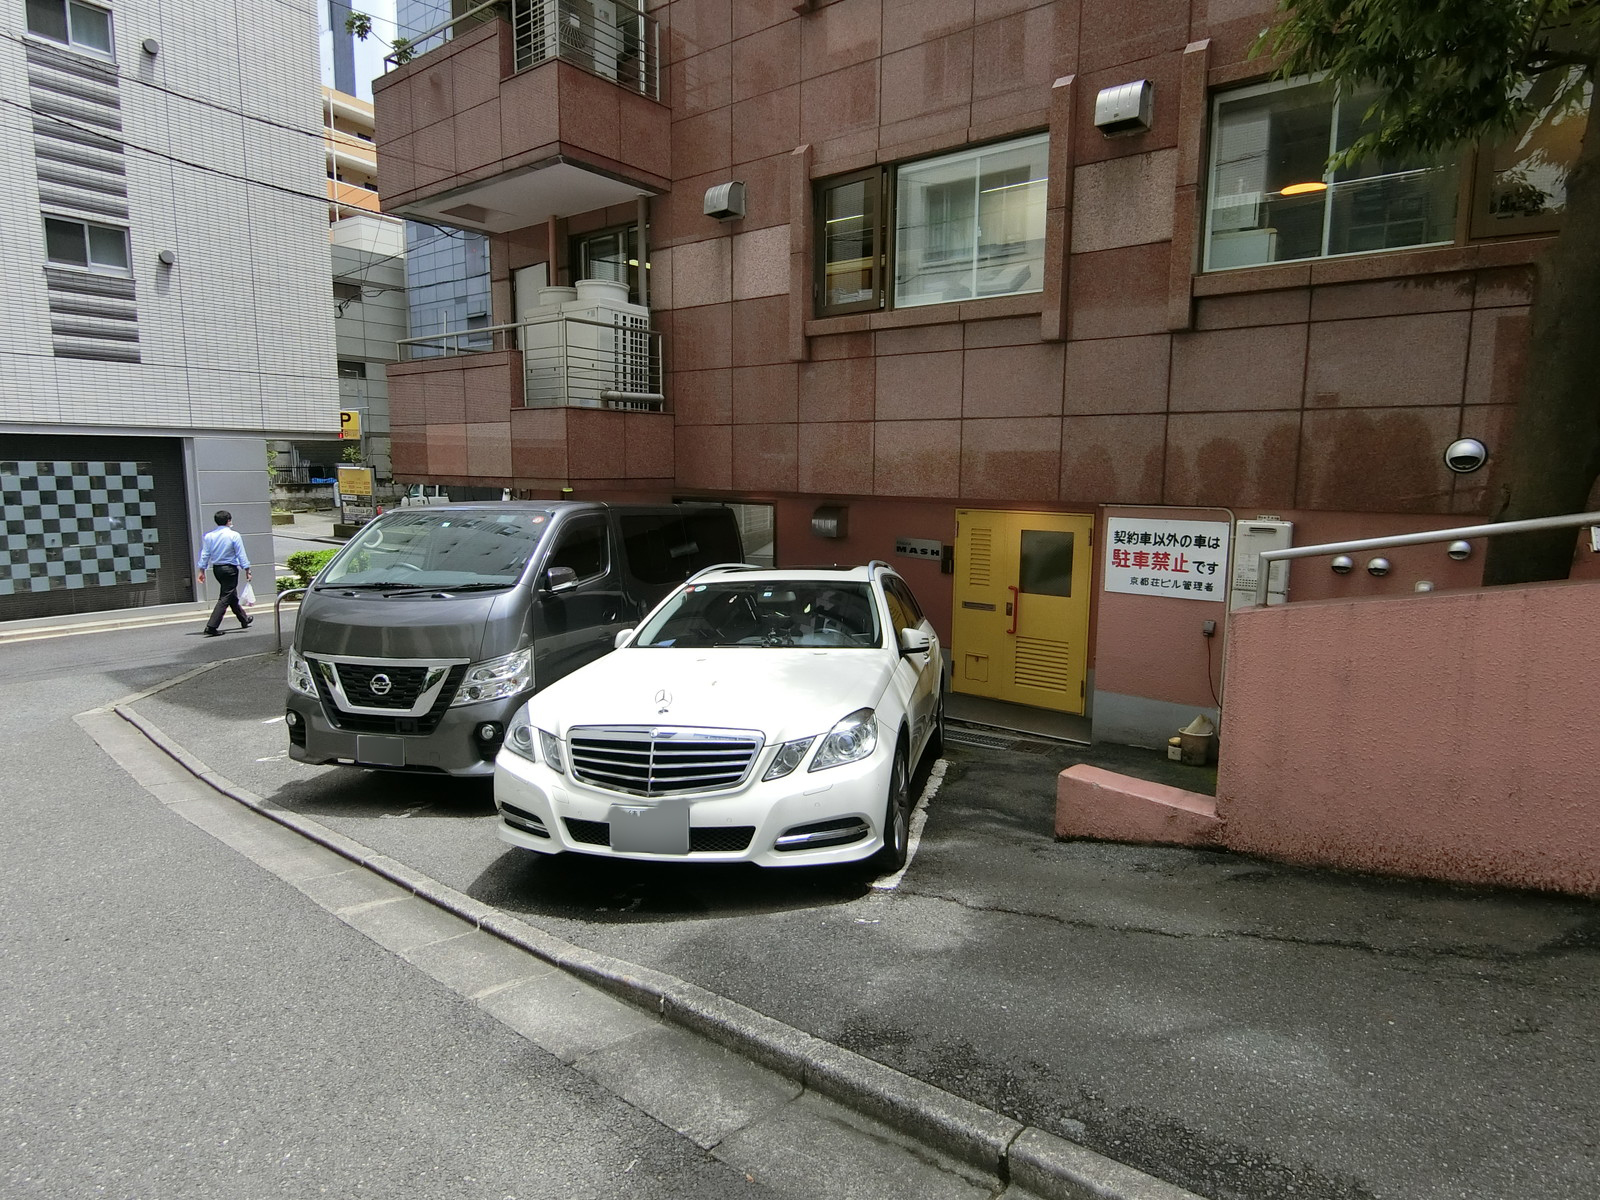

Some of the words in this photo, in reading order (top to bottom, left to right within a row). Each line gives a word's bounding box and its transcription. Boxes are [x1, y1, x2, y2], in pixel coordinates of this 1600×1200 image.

[340, 412, 351, 428] P
[1113, 530, 1221, 549] 契約車以外の車は
[896, 546, 940, 556] MASH
[1111, 548, 1219, 575] 駐車禁止です
